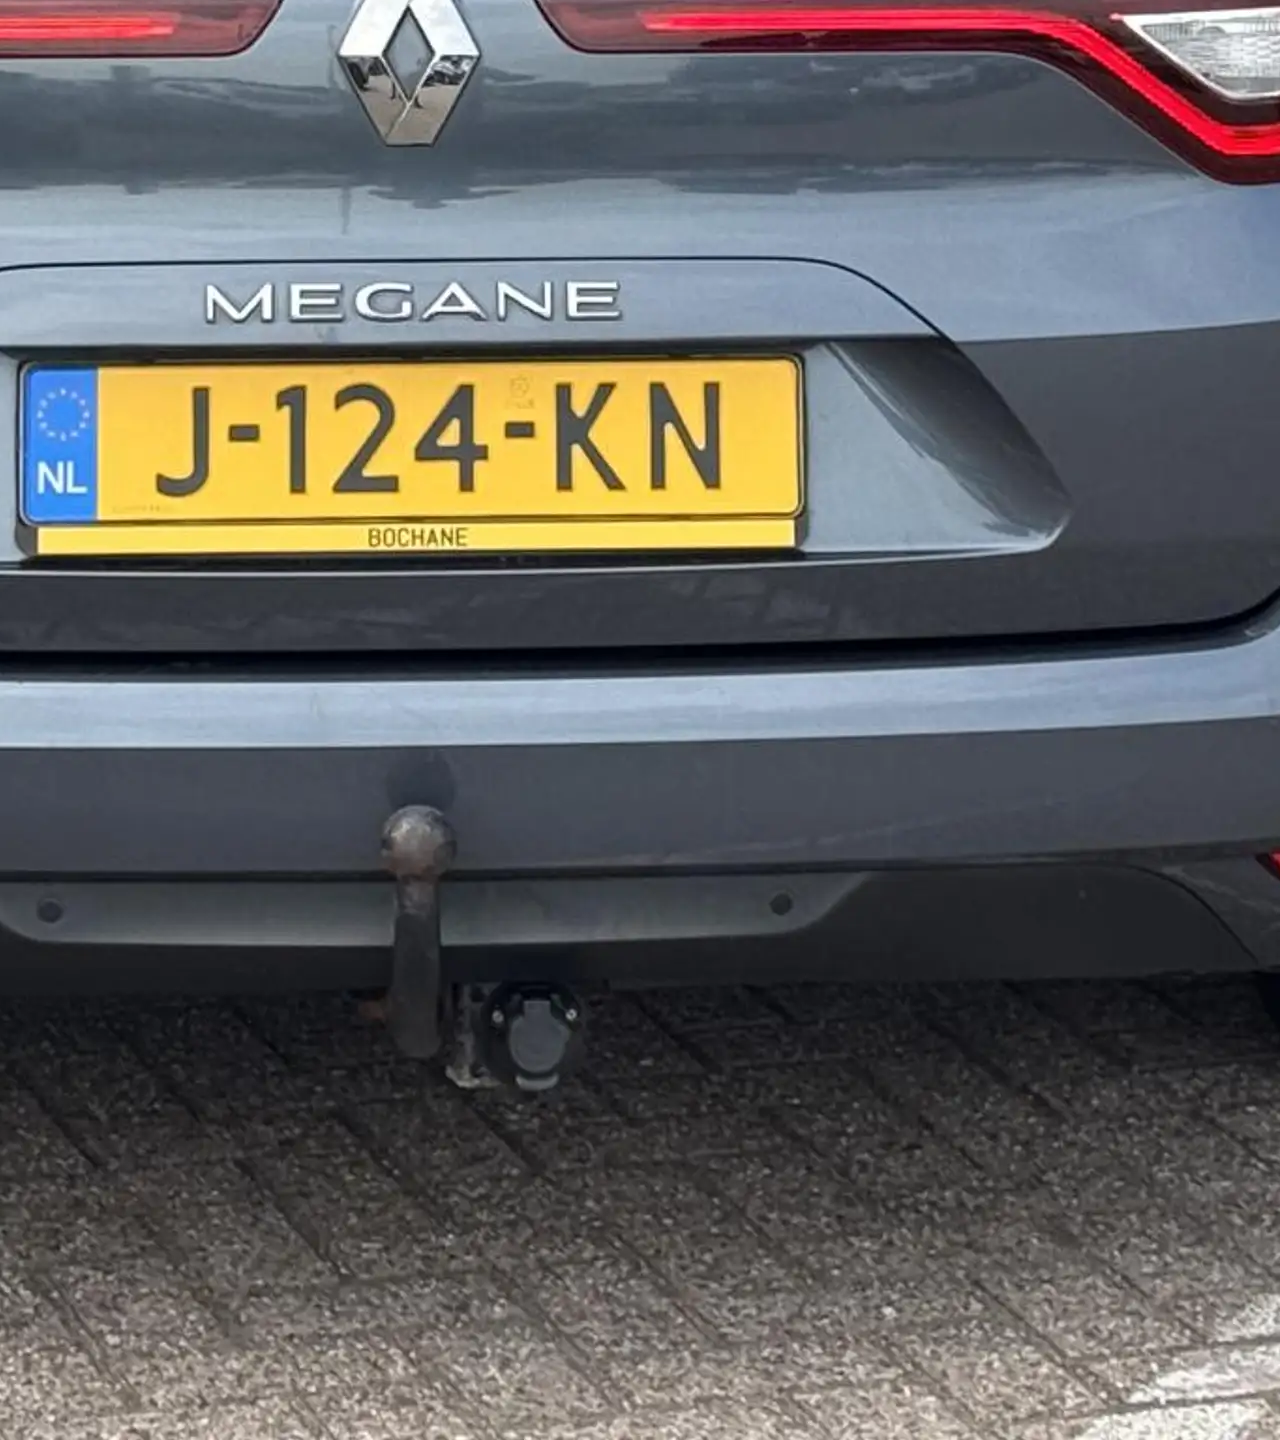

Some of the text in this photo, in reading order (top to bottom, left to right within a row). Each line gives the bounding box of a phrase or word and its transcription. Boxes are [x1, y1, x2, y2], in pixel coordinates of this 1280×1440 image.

[204, 280, 622, 323] MEGANE
[155, 381, 723, 498] J-124-KN
[36, 460, 88, 495] NL
[367, 526, 469, 548] BOCHANE
